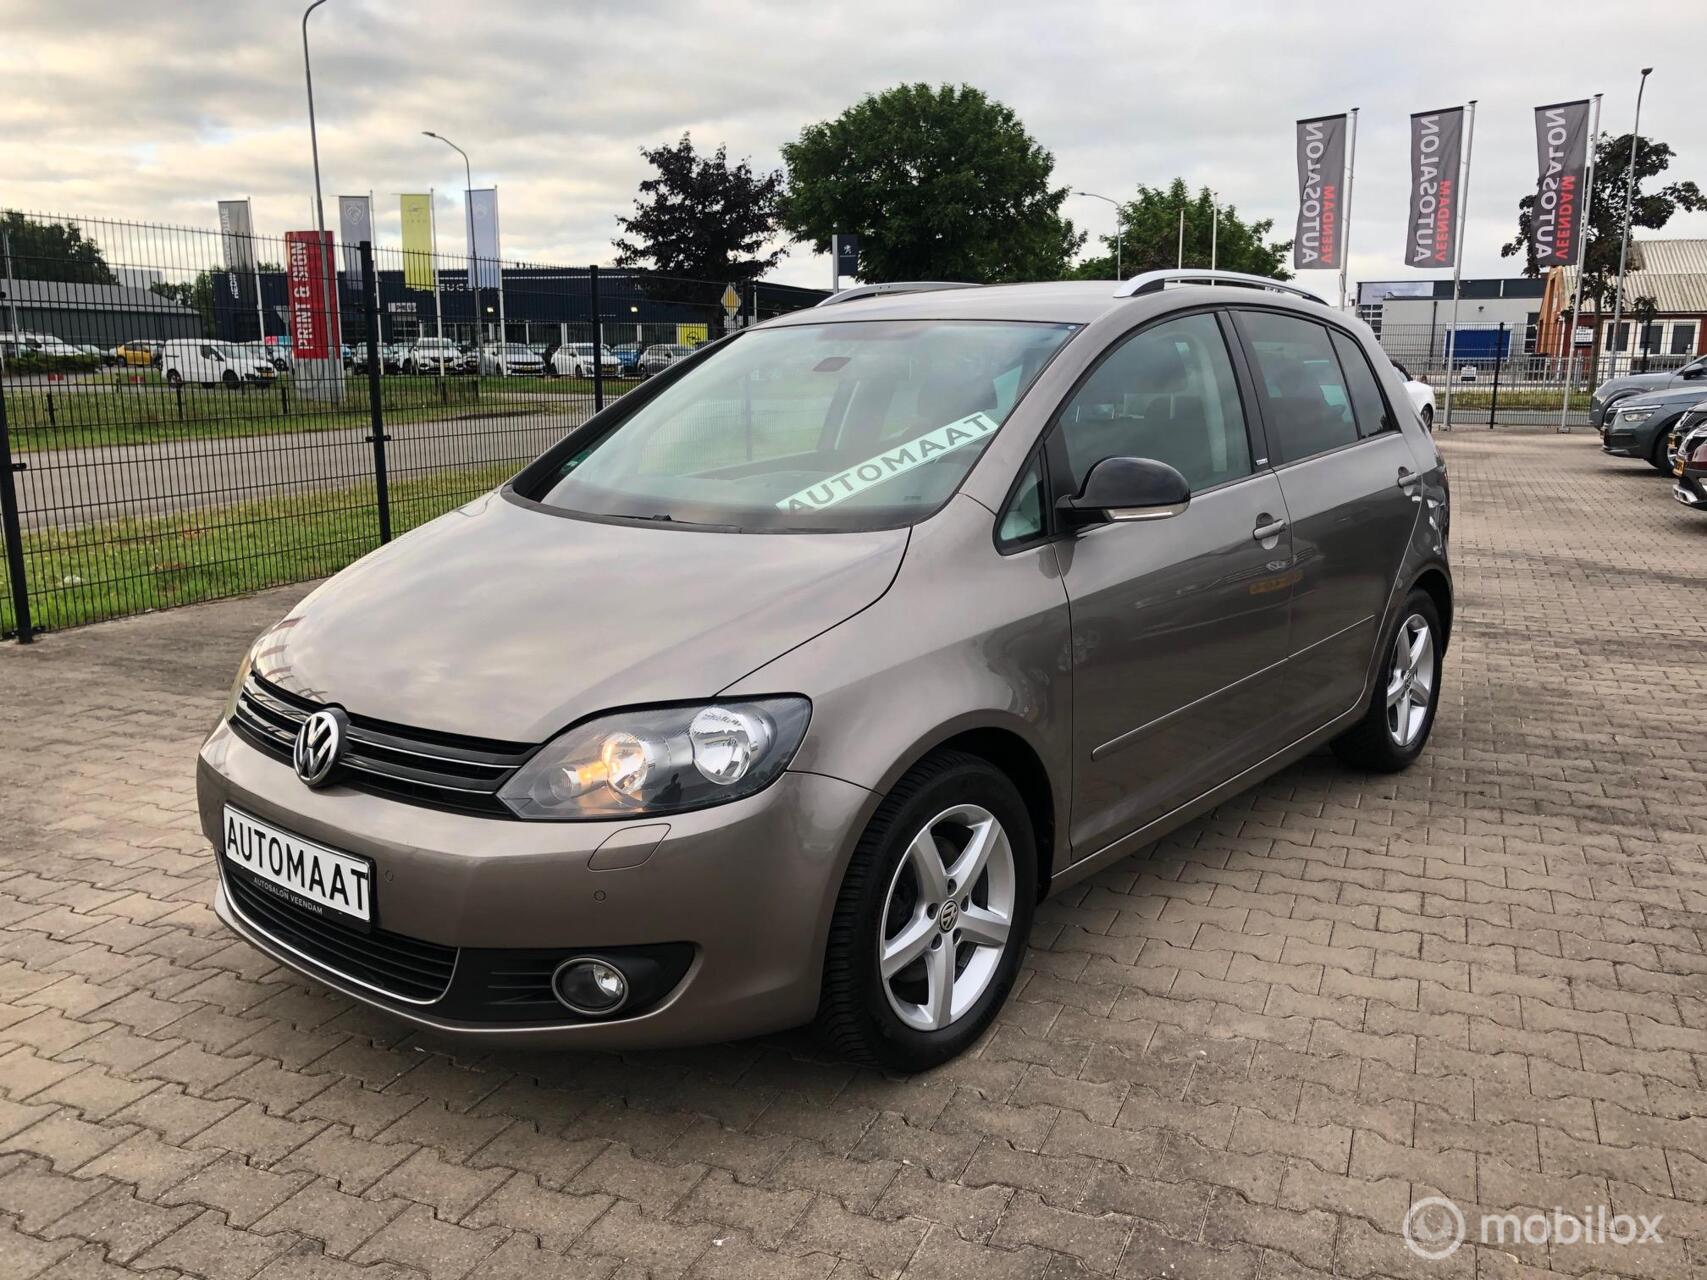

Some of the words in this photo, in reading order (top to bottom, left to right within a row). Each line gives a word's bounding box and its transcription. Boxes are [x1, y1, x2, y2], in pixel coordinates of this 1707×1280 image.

[290, 242, 309, 282] SIGN
[296, 302, 314, 350] PRINT
[786, 414, 989, 513] AUTOMAAT
[227, 816, 369, 911] AUTOMAAT
[253, 877, 290, 900] AUTOSALON
[290, 895, 323, 916] VEENDAM
